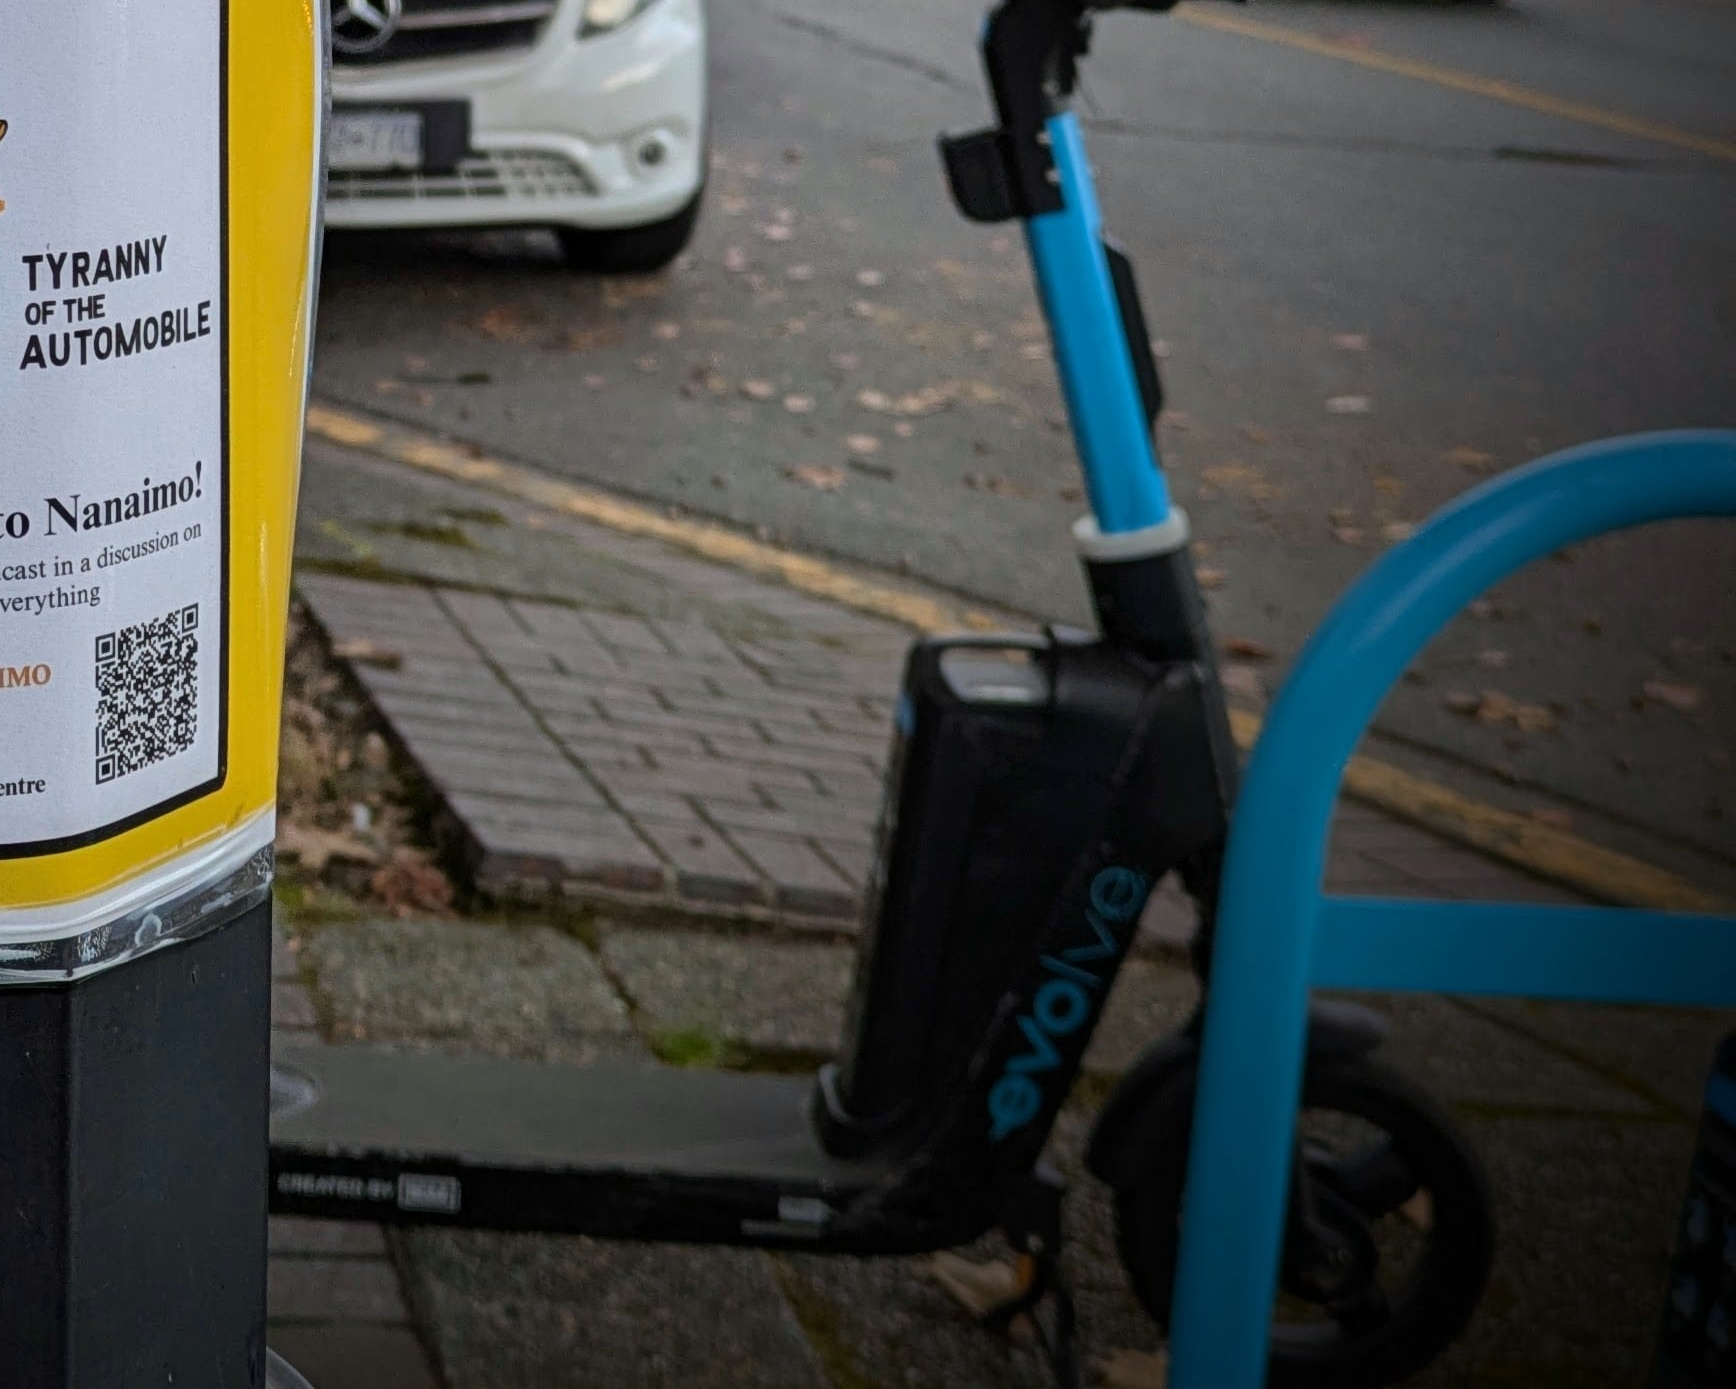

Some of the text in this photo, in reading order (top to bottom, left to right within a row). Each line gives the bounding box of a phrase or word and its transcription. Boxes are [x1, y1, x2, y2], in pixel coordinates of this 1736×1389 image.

[22, 234, 168, 291] TYRANNY
[19, 300, 211, 370] AUTOMOBILE
[25, 294, 106, 325] OF THE
[43, 460, 203, 536] Nanaimo!
[54, 555, 74, 577] in
[80, 557, 92, 572] a
[97, 531, 179, 569] discussion
[183, 523, 202, 542] on
[987, 865, 1148, 1143] evolve
